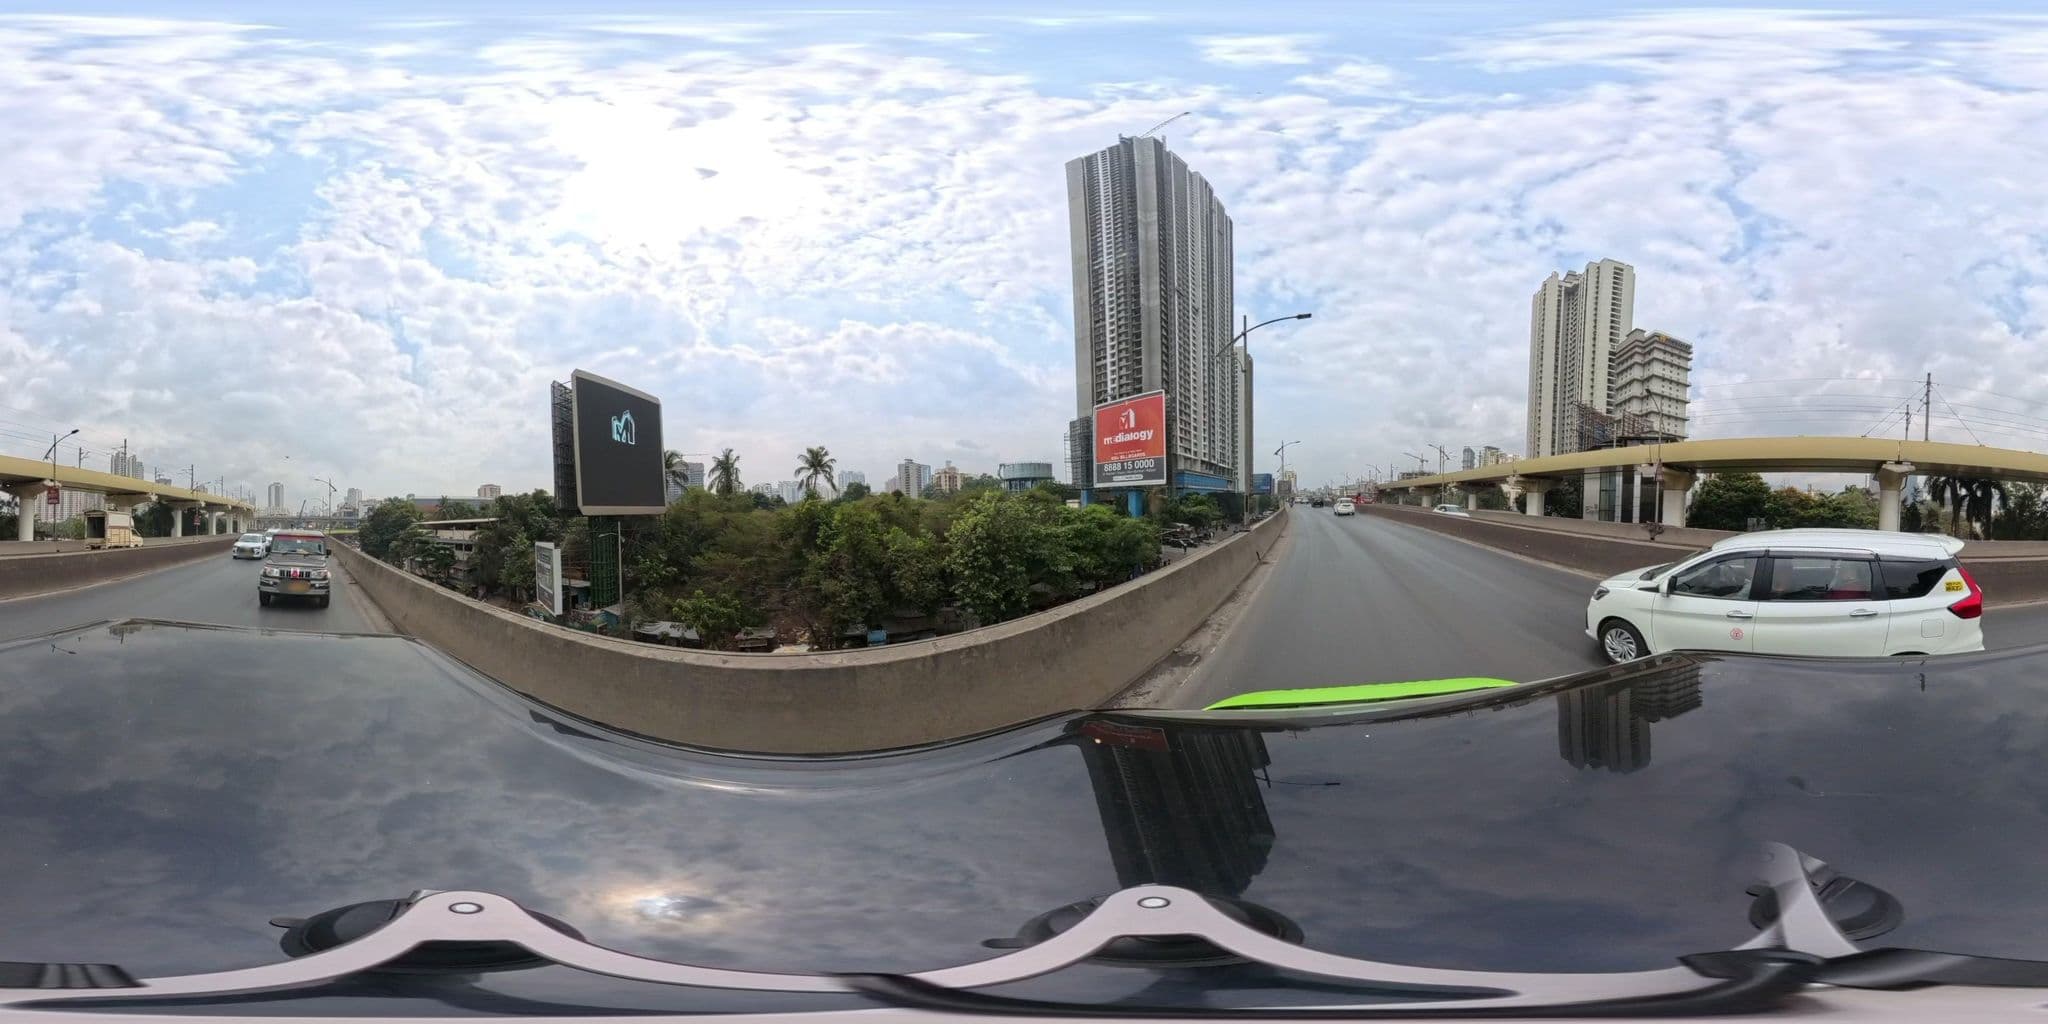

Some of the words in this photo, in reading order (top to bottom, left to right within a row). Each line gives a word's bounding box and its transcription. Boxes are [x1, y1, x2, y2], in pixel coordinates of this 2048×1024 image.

[1103, 463, 1121, 472] 8888
[1124, 461, 1133, 470] 15
[1134, 459, 1154, 469] 0000
